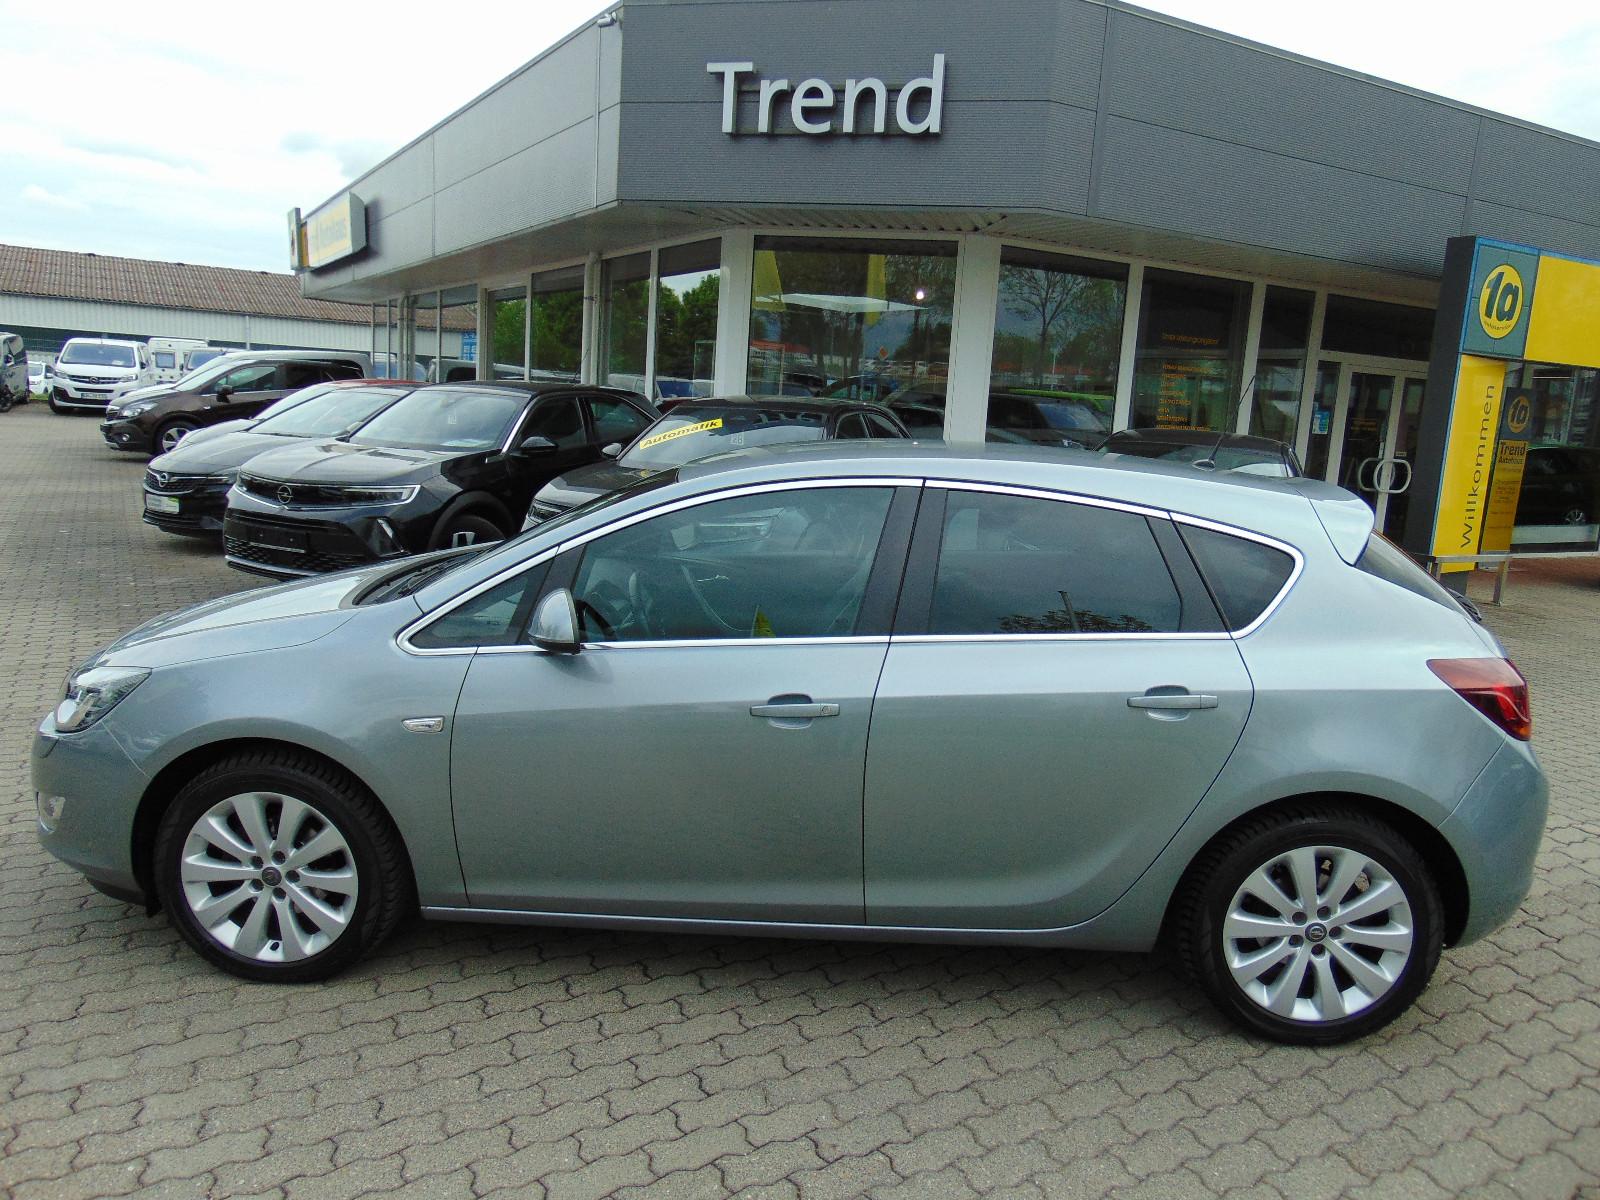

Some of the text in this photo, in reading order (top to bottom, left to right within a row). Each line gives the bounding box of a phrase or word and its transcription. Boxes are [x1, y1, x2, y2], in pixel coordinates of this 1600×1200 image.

[706, 53, 945, 135] Trend
[1484, 271, 1520, 322] 1a
[643, 420, 719, 447] Automatik
[1500, 441, 1526, 456] Trend
[1460, 384, 1495, 549] Willkommen
